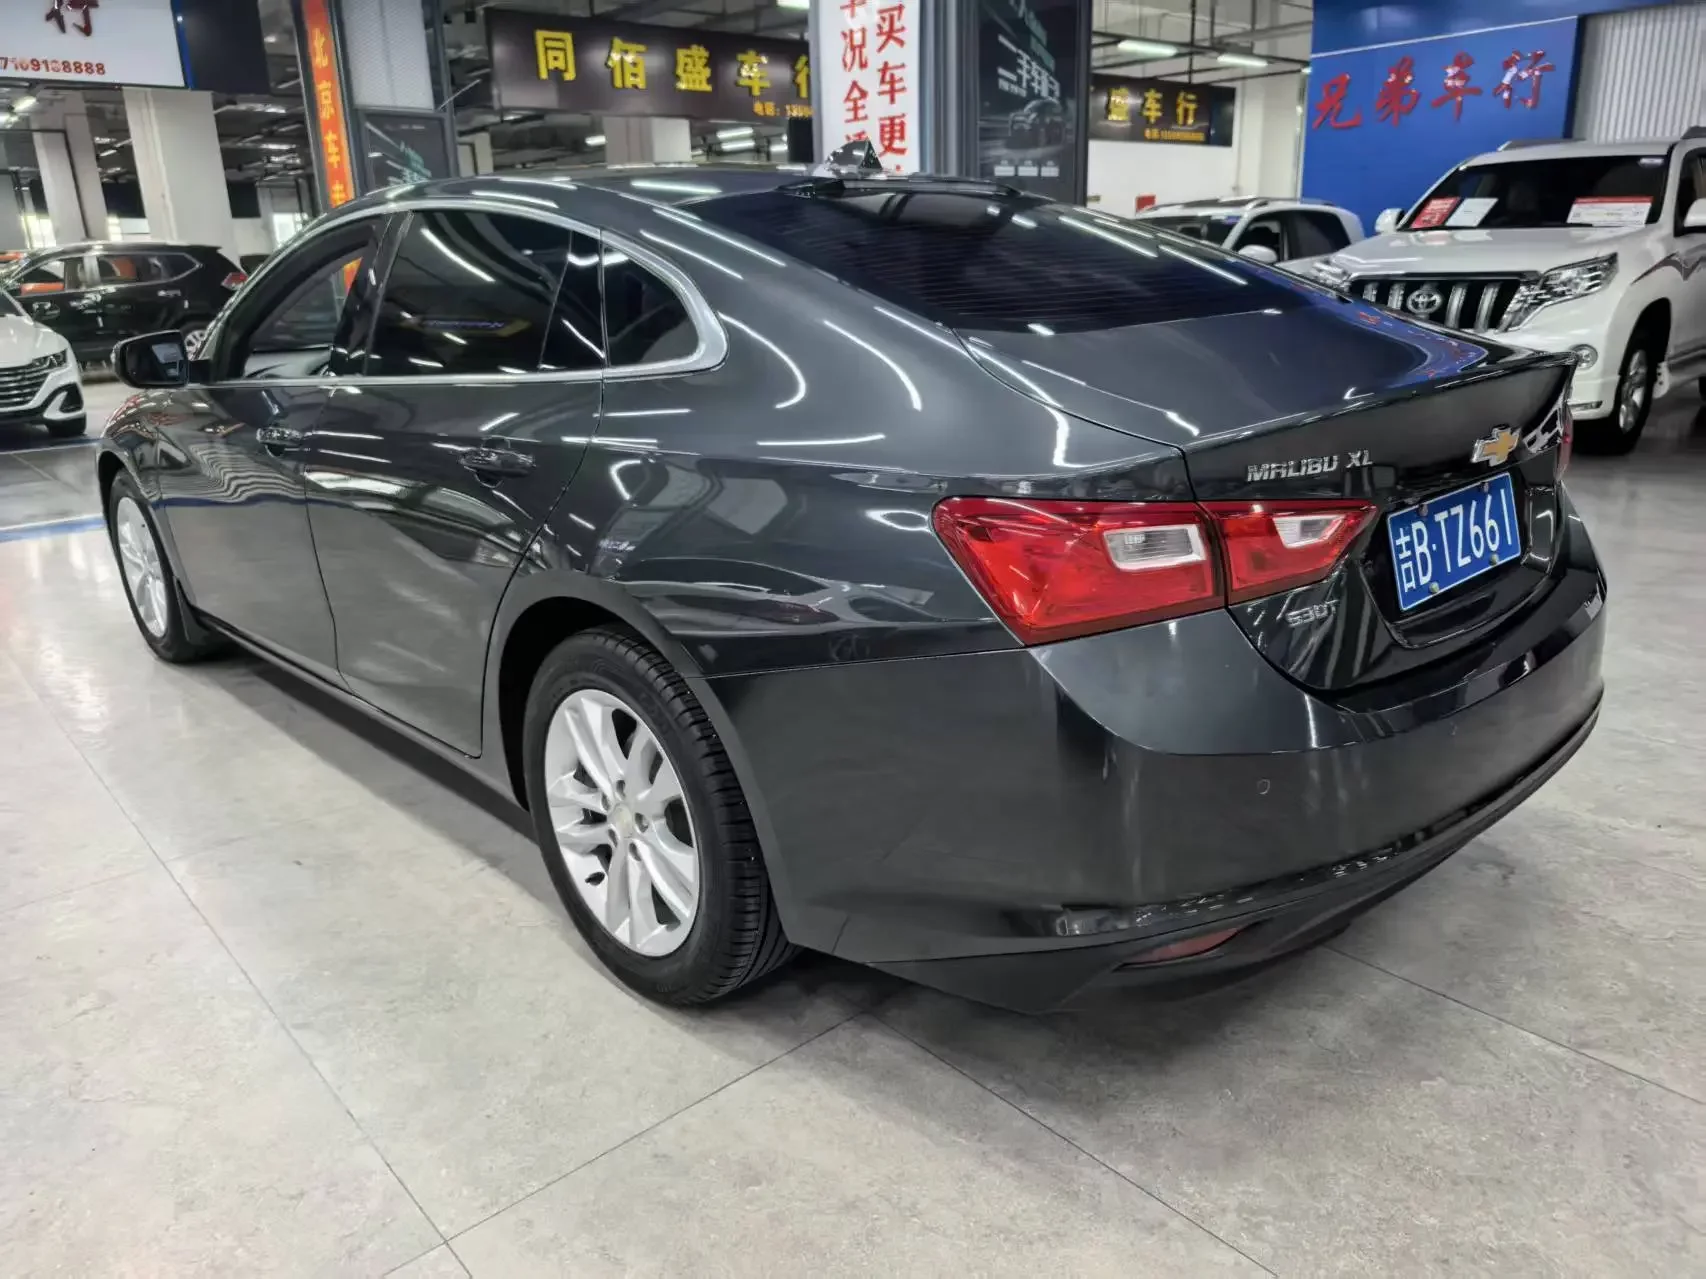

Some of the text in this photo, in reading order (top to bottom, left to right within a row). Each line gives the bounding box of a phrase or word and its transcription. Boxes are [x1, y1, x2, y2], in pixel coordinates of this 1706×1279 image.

[840, 0, 870, 143] 况全
[876, 3, 907, 172] 买车更
[1312, 49, 1557, 130] 兄弟车行
[1246, 449, 1373, 482] MALIBU XL
